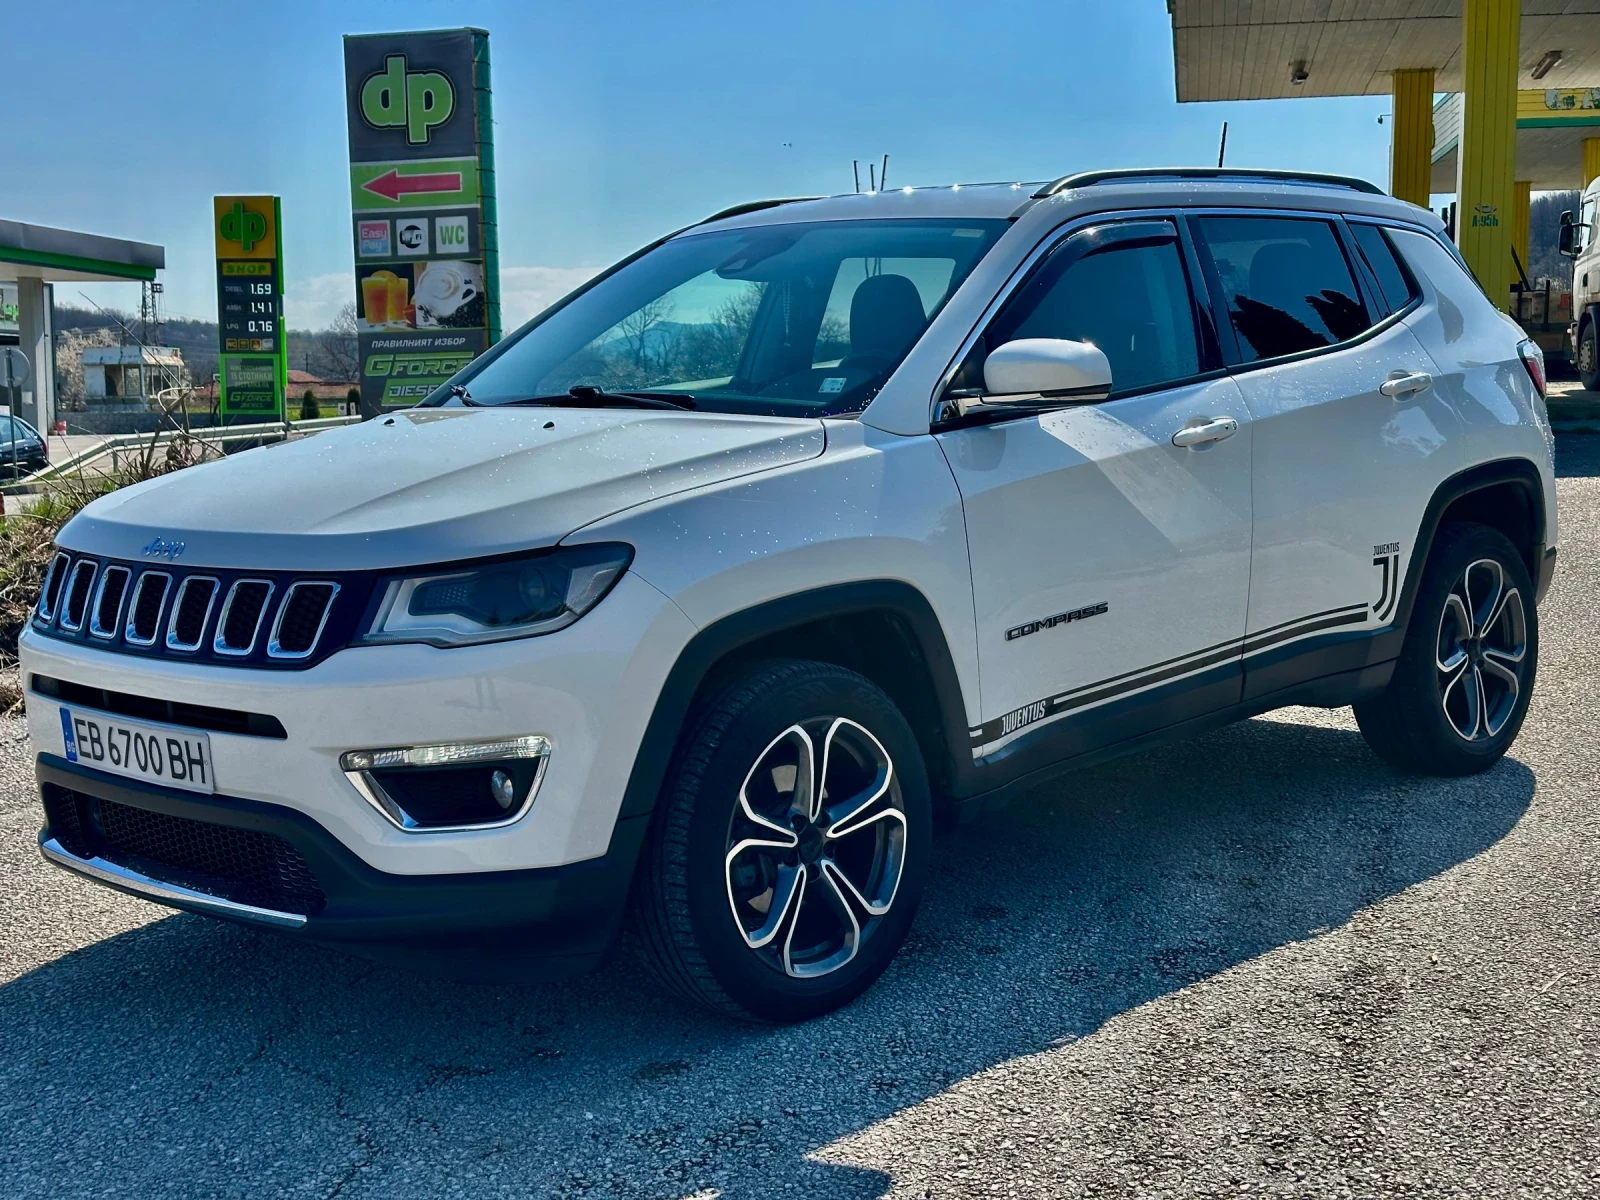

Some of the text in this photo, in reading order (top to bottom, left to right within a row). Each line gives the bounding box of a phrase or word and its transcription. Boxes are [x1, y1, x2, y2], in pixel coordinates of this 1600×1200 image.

[360, 55, 455, 144] dp
[220, 202, 266, 252] dp
[361, 227, 387, 239] Easy
[440, 225, 465, 245] WC
[363, 240, 382, 252] Pay
[226, 264, 267, 275] SHOP
[251, 283, 272, 295] 1.69
[251, 302, 272, 313] 1.41
[248, 320, 273, 332] 0.76
[371, 337, 466, 349] ПРАВИЛНИЯТ ИЗБОР
[388, 384, 439, 397] DIESE
[141, 536, 186, 562] Jeep
[1373, 541, 1400, 556] JUVENTUS
[1005, 601, 1109, 642] COMPASS
[1001, 700, 1046, 736] JUVENTUS
[66, 740, 76, 754] BG
[74, 718, 206, 784] EB 6700 BH
